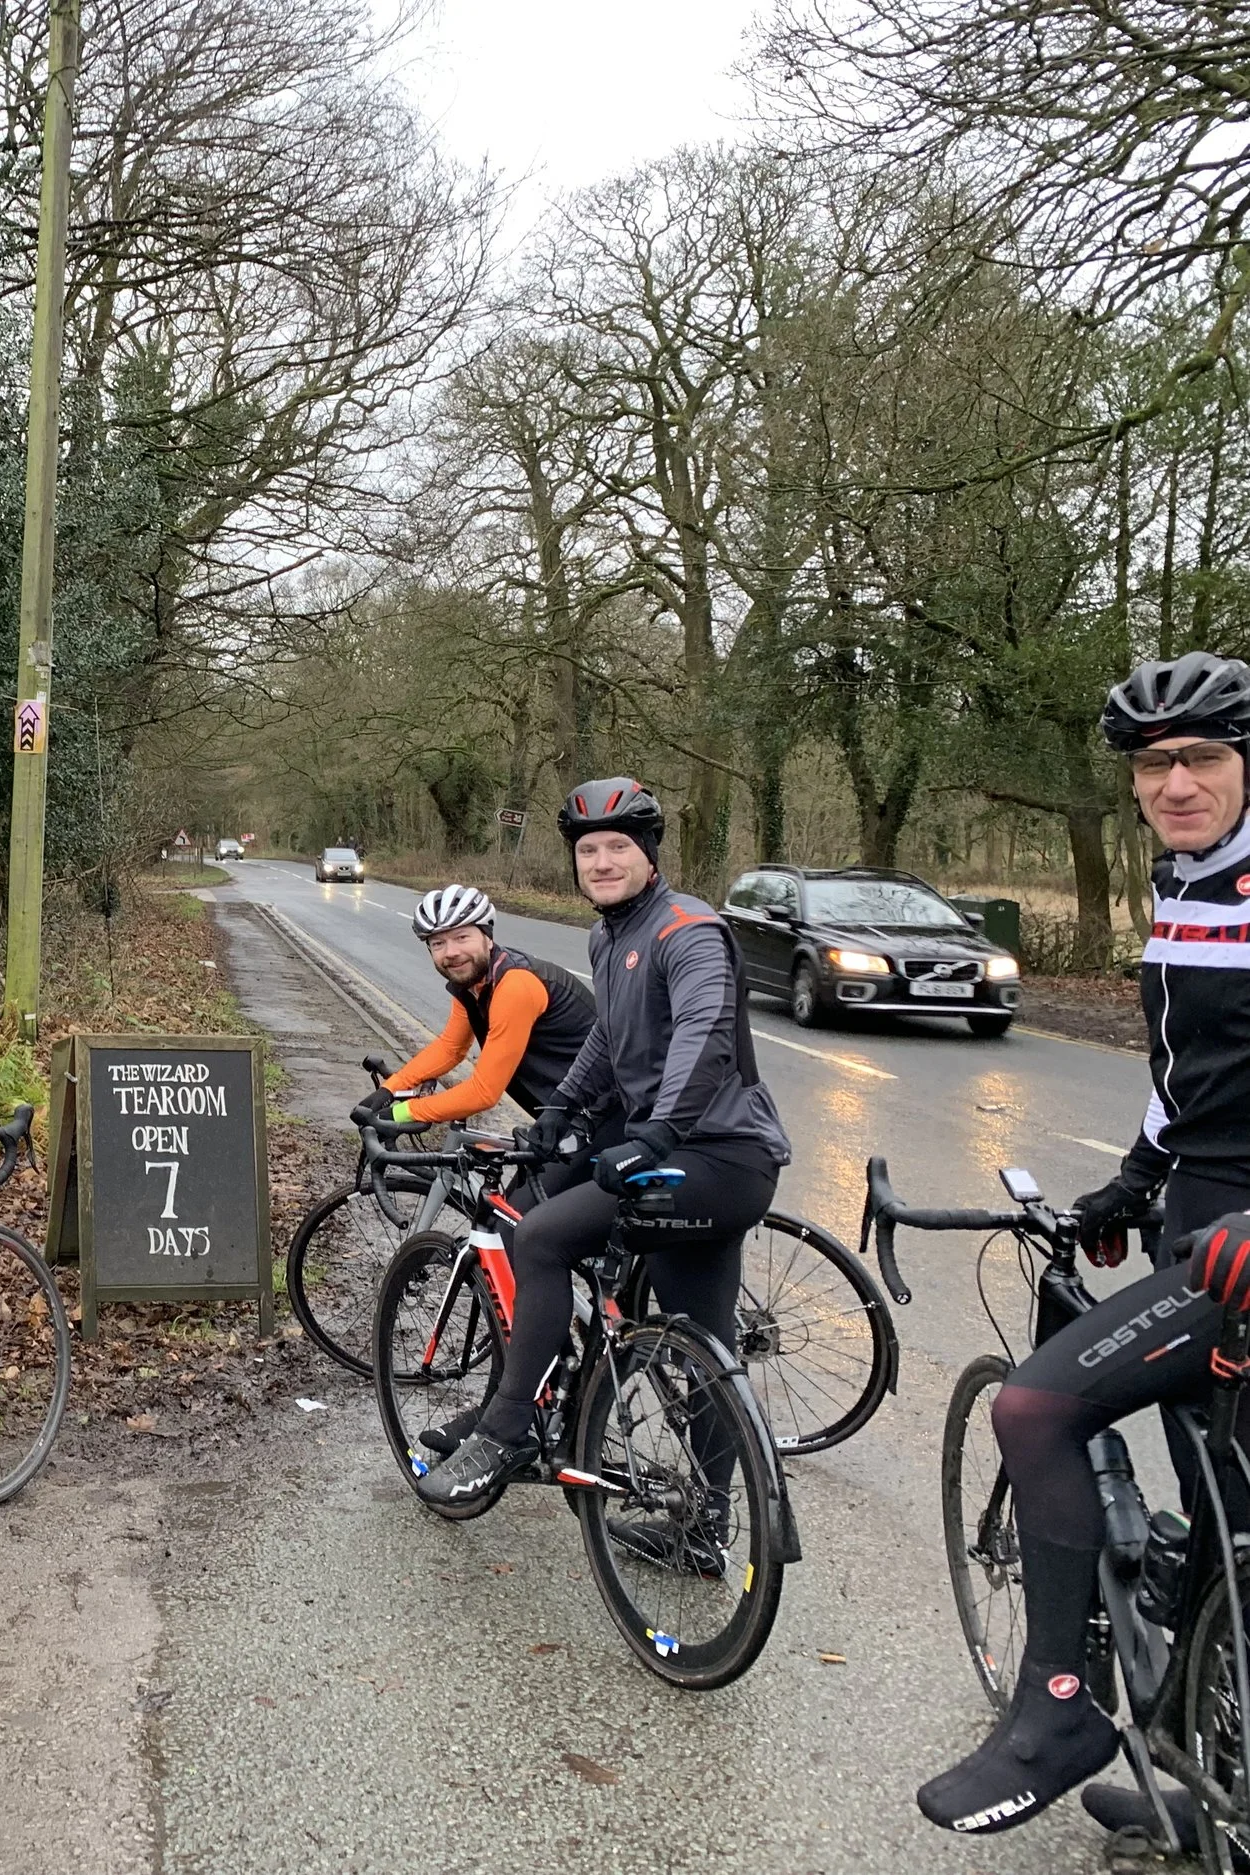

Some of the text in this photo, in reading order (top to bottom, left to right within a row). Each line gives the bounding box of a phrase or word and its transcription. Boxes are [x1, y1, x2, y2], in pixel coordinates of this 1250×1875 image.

[108, 1063, 210, 1083] THE WIZARD
[113, 1086, 228, 1116] TEAROOM
[131, 1126, 189, 1155] OPEN
[145, 1161, 179, 1219] 7
[147, 1226, 211, 1257] DAYS
[1077, 1285, 1210, 1368] CASTELL
[952, 1791, 1037, 1832] CASTELLI
